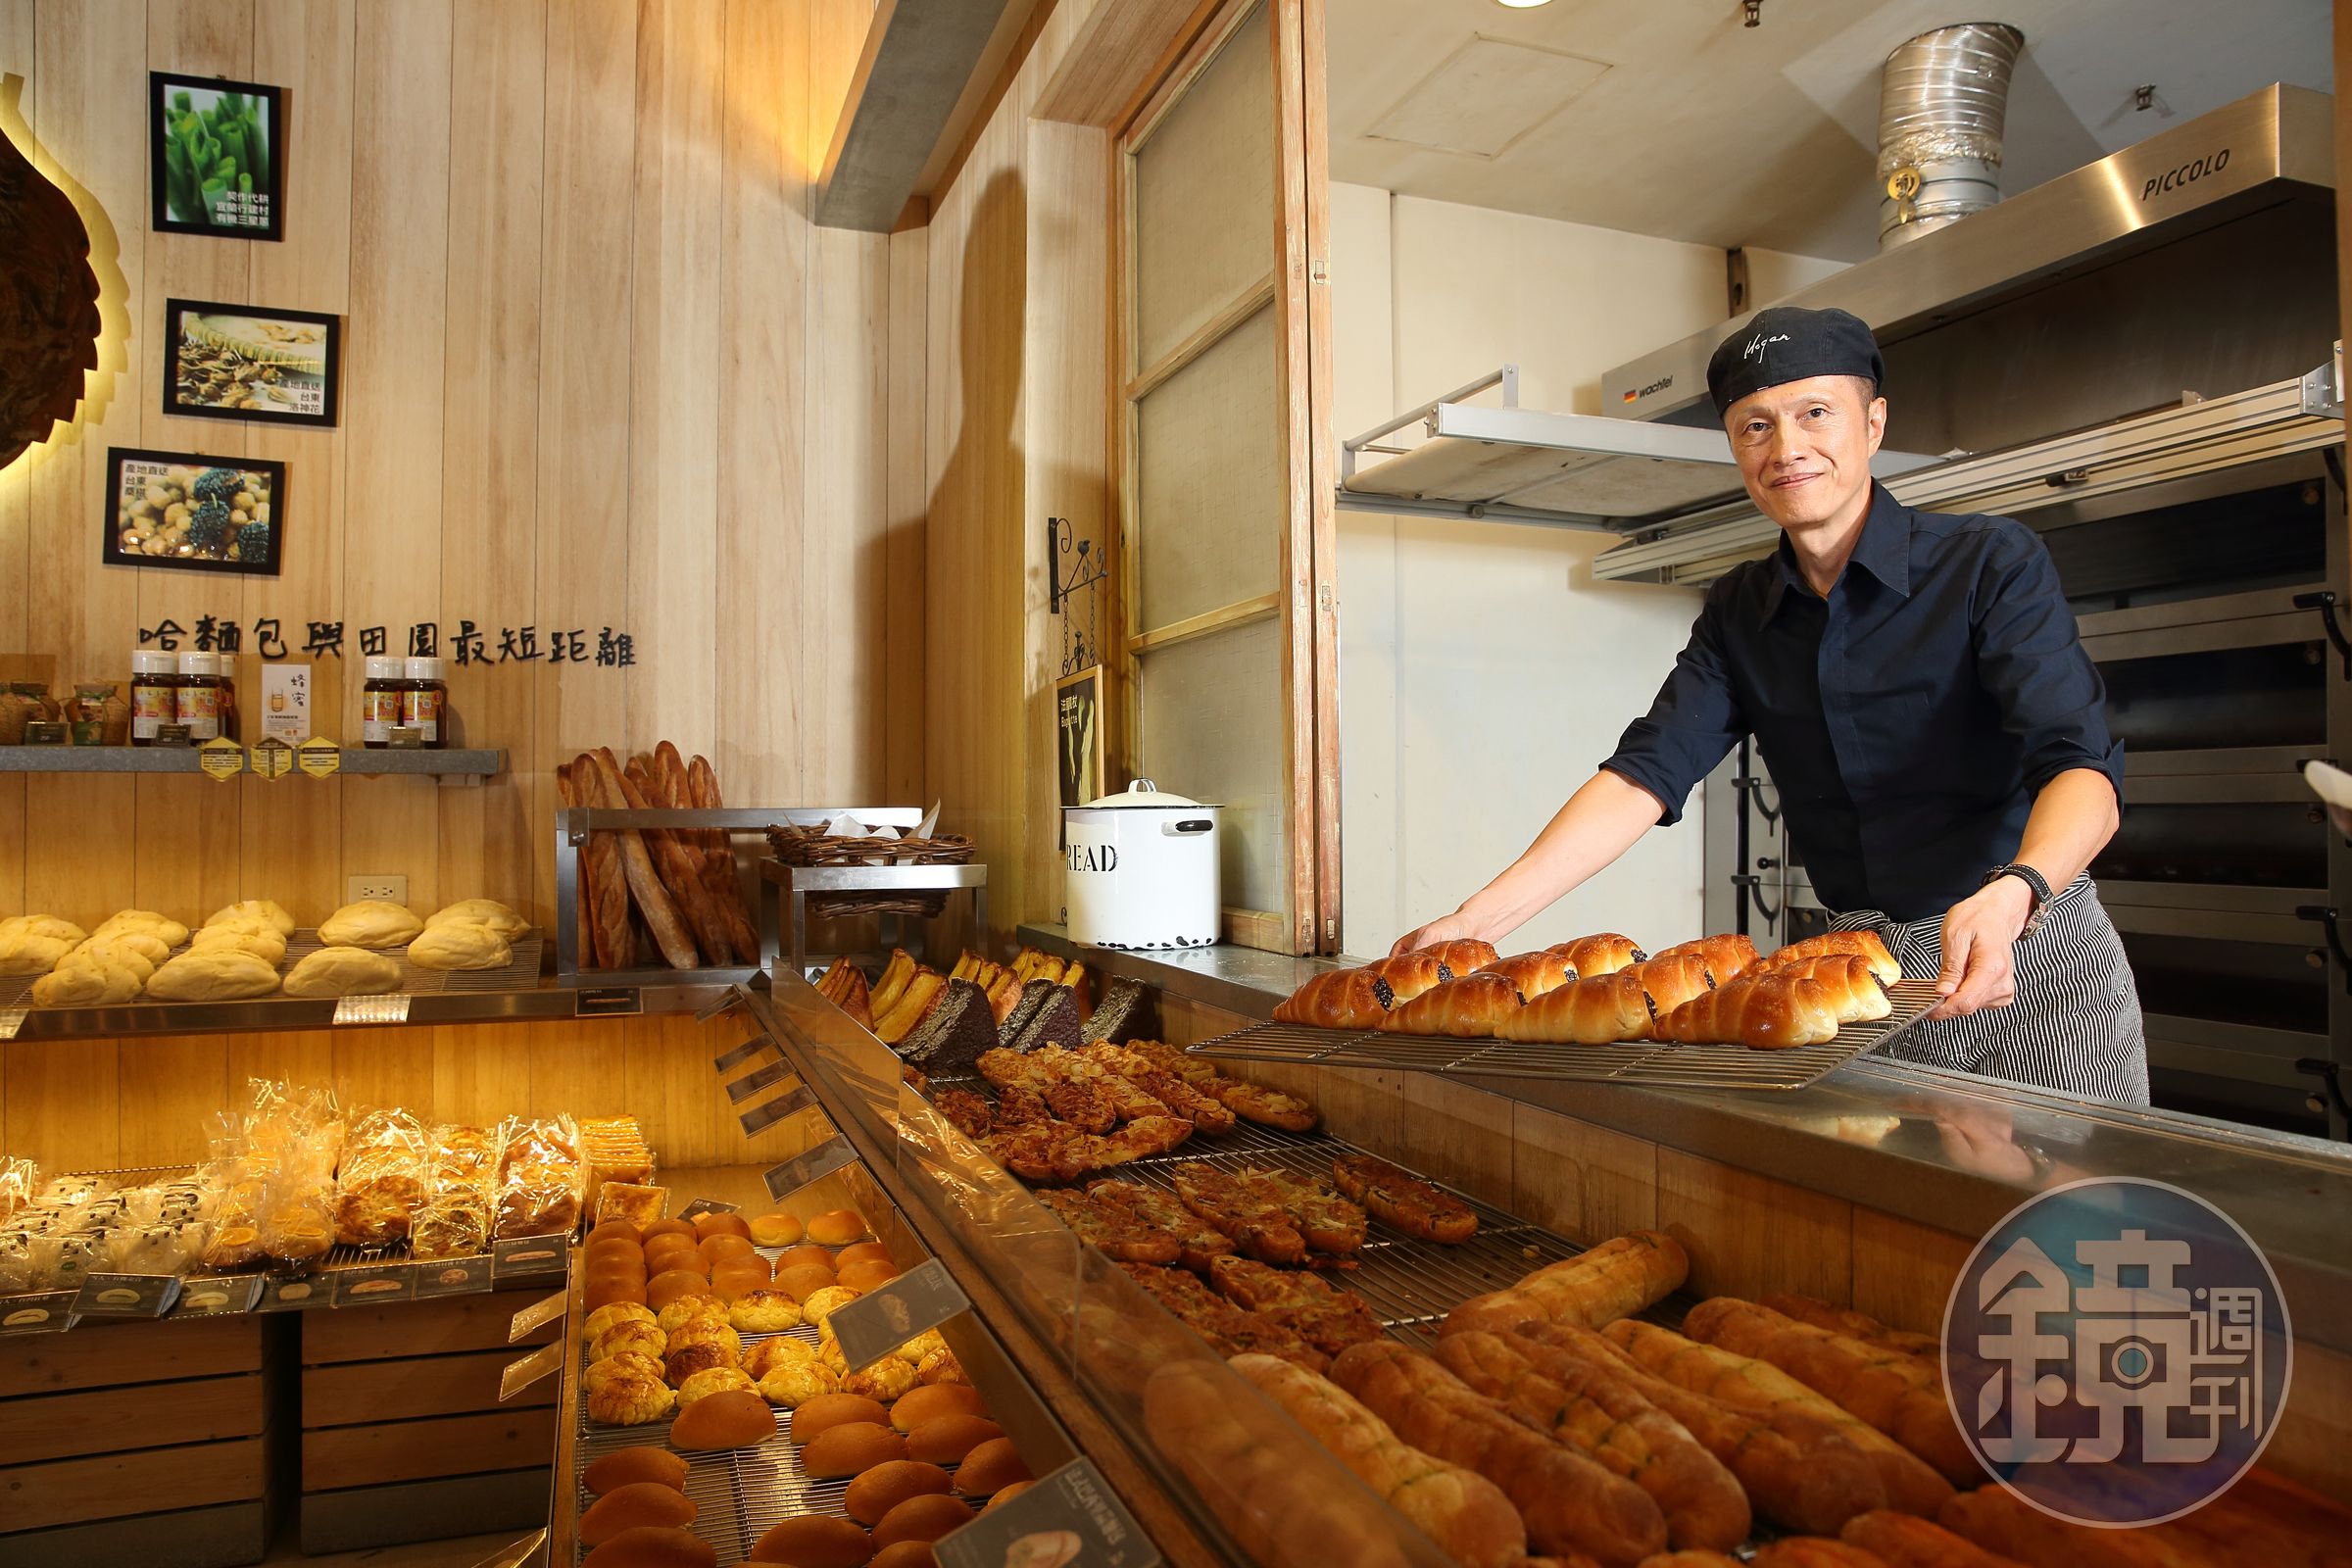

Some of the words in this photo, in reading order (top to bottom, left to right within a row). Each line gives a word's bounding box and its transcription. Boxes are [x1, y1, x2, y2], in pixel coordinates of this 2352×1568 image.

[2142, 148, 2230, 201] PICCOLO
[1743, 333, 1791, 364] Hogan
[300, 392, 320, 403] 台東
[1639, 374, 1674, 399] wachtel
[124, 464, 169, 476] 產地直送
[124, 475, 147, 486] 台東
[139, 614, 637, 668] 哈麵包與田園最短距離
